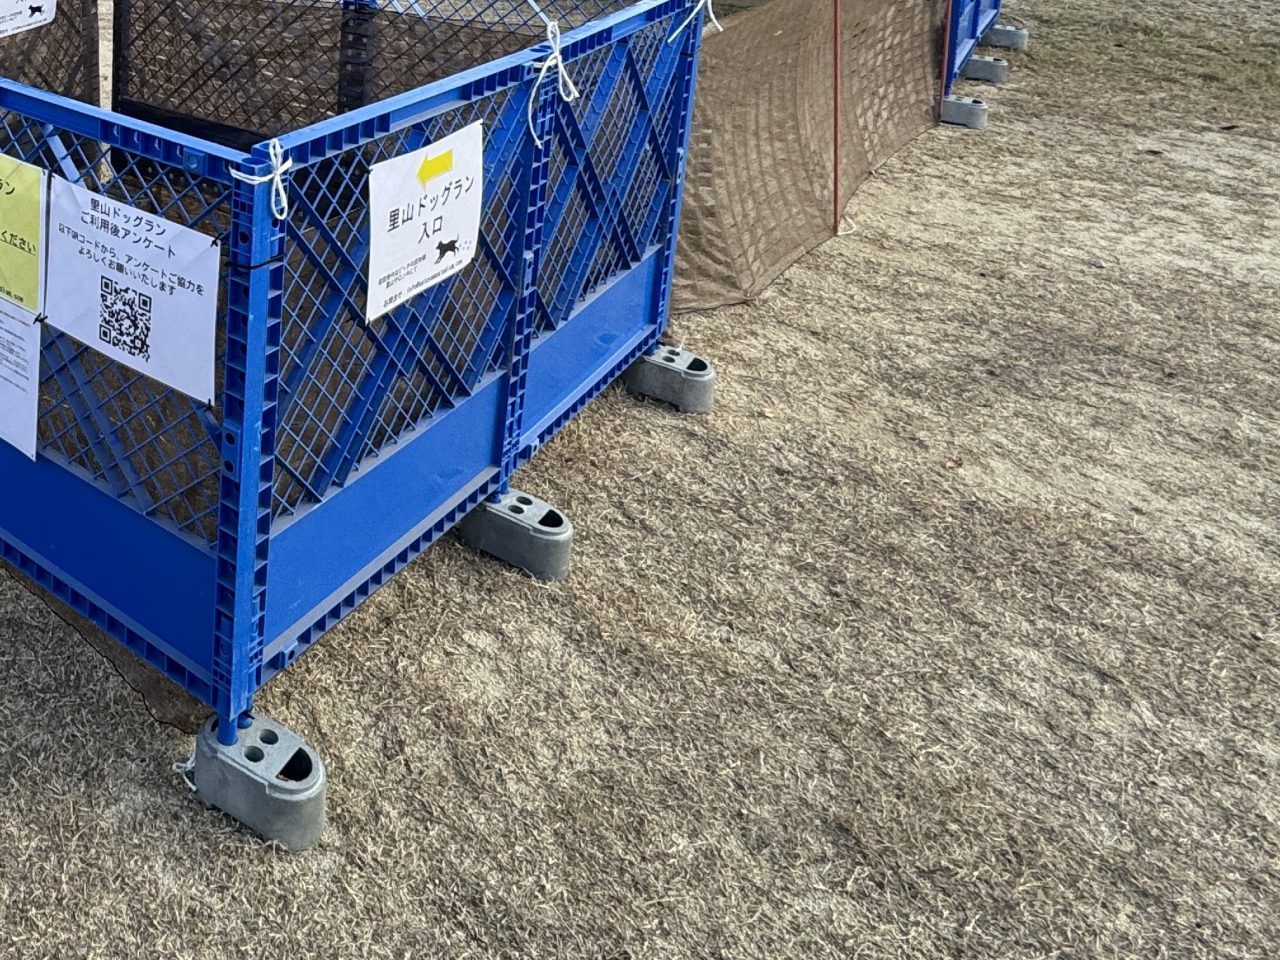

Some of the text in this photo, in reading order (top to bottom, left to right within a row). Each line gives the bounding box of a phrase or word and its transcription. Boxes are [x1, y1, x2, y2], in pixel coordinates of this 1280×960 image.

[90, 198, 167, 236] 里山ドッグラン
[387, 176, 475, 233] 里山ドッグラン
[81, 210, 176, 259] ご利用後アンケート
[418, 215, 443, 244] 入口
